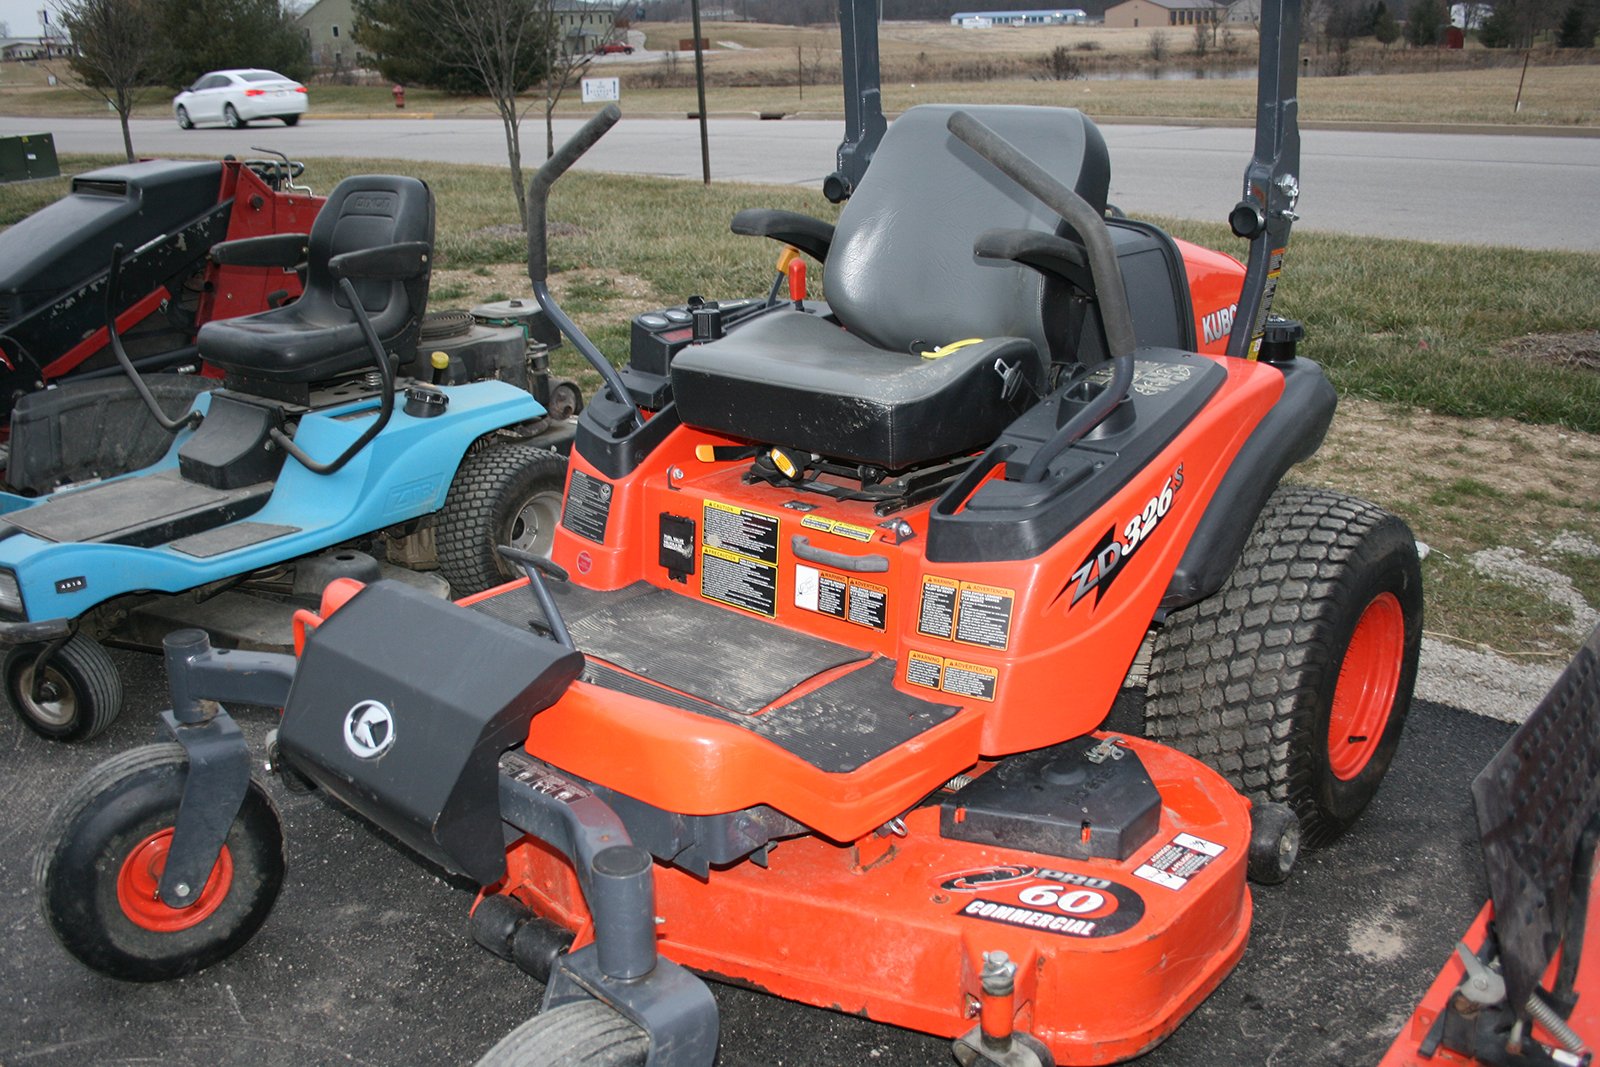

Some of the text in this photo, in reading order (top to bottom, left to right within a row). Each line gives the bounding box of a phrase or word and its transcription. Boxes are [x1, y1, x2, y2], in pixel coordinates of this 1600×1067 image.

[933, 578, 955, 586] WARNING
[973, 585, 1009, 595] ADVERTENCIA
[916, 653, 940, 663] WARNING
[954, 661, 993, 674] ADVERTENCIA
[1034, 867, 1112, 889] PRO
[1018, 885, 1105, 914] 60
[965, 900, 1097, 936] COMMERCIAL
